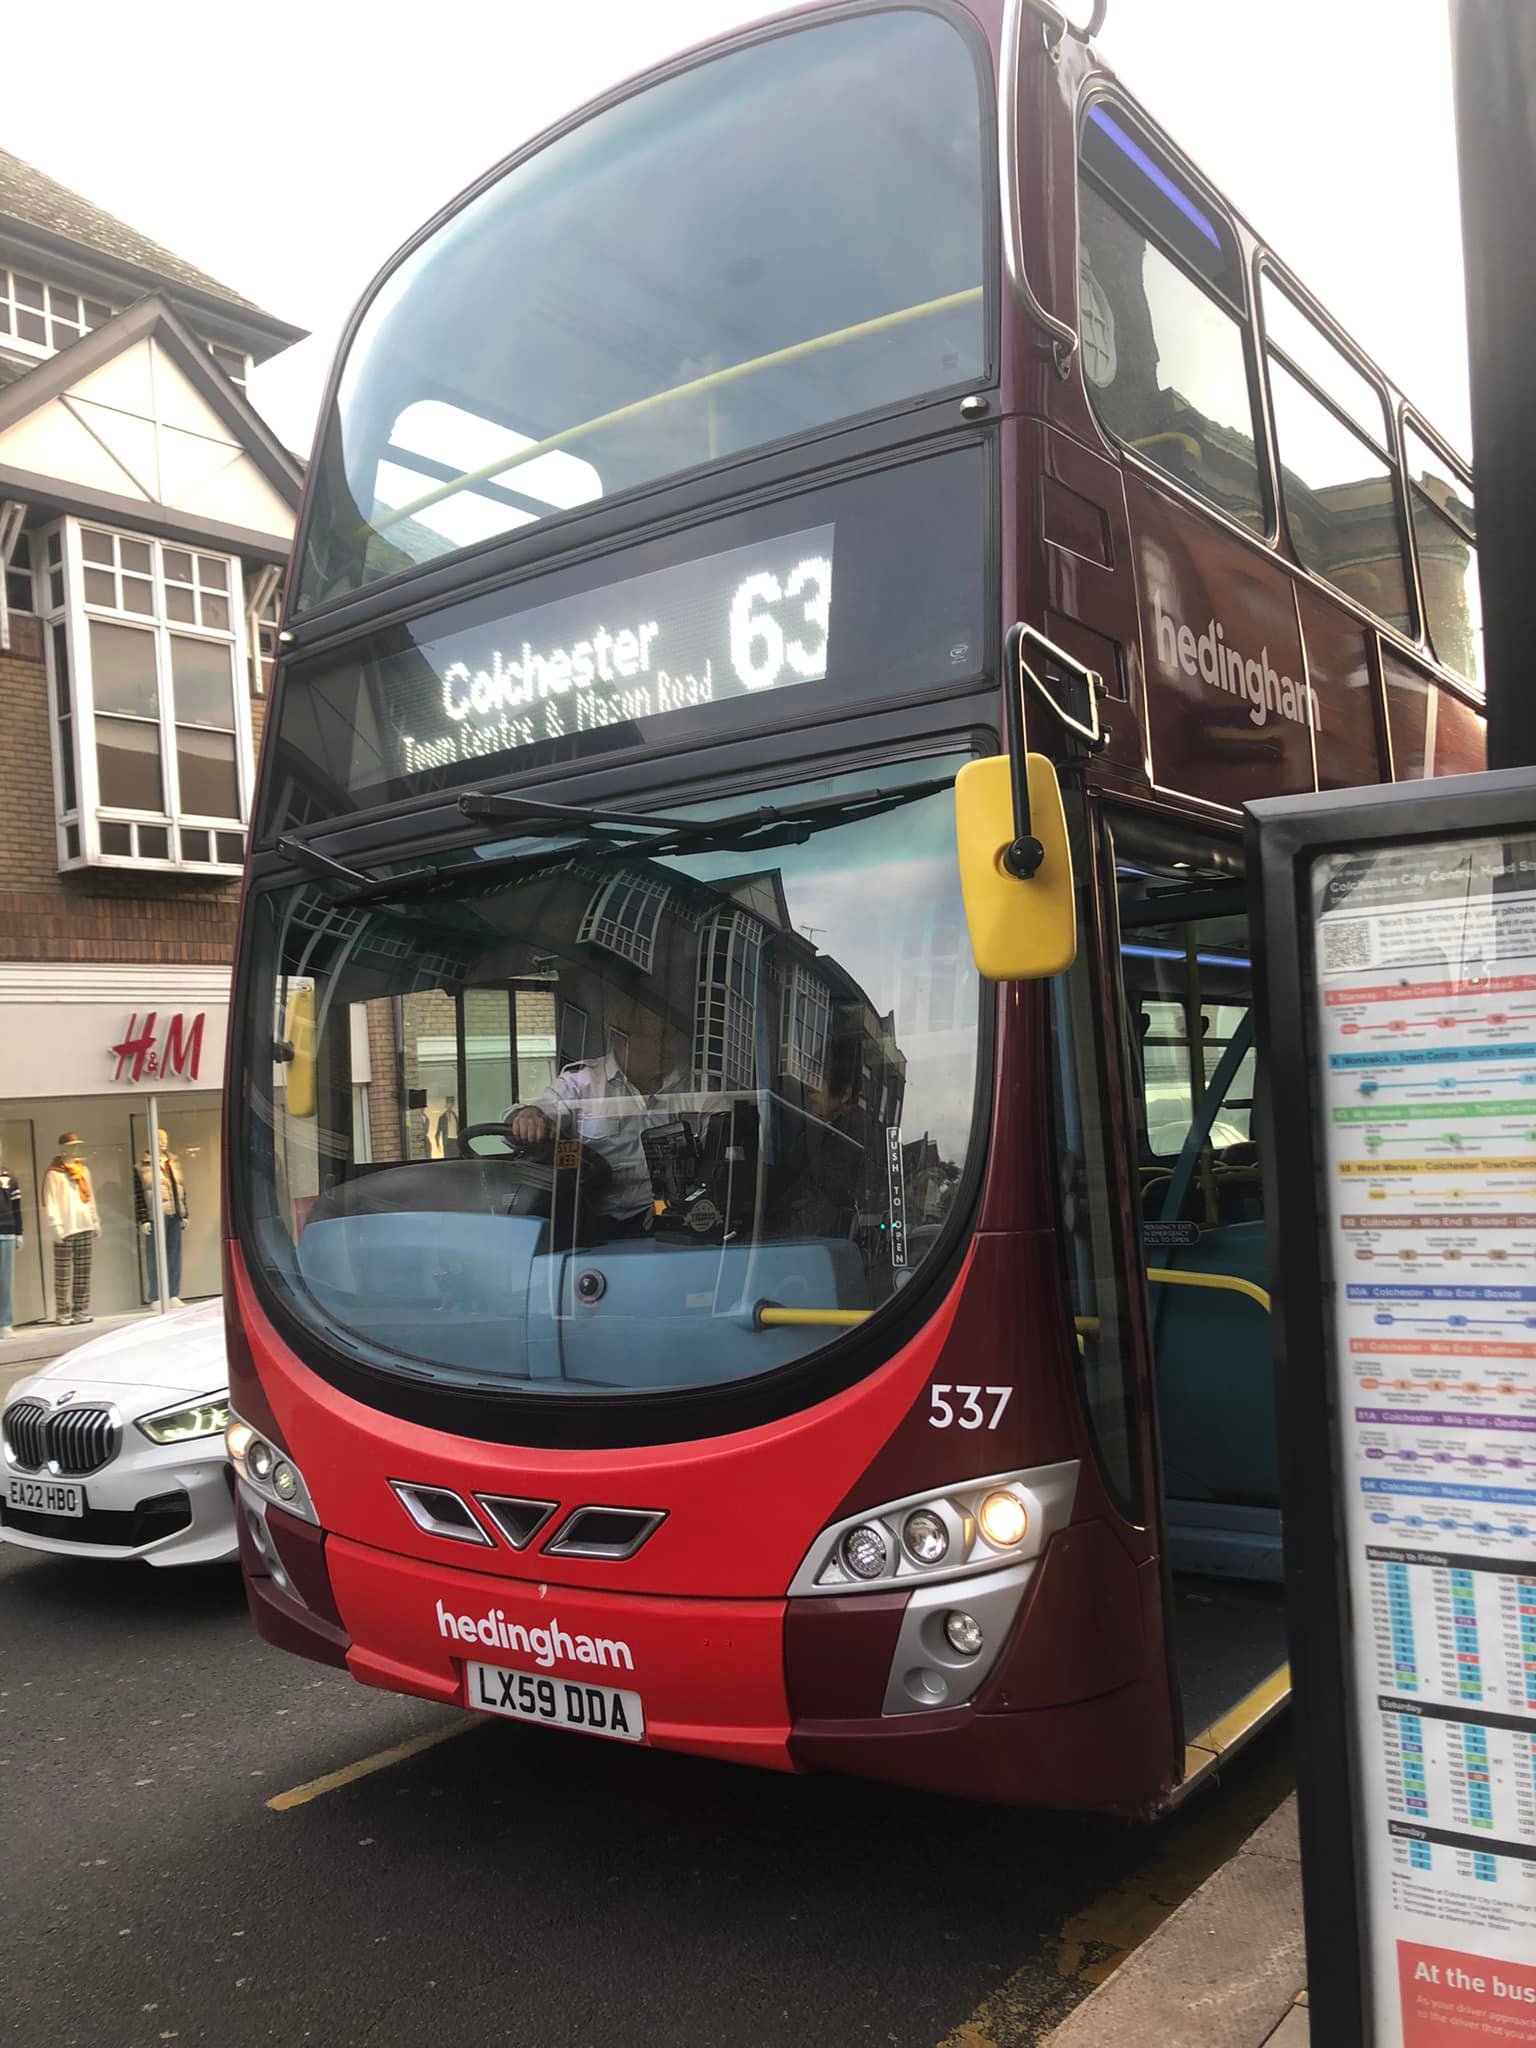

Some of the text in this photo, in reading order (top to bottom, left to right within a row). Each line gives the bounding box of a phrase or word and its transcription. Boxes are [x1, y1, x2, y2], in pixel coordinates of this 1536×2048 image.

[729, 555, 832, 691] 63
[441, 619, 660, 721] Colchester
[1154, 588, 1322, 732] hedingham
[402, 658, 713, 774] Town Centre & Mason Road
[109, 1011, 206, 1082] H&M
[889, 1129, 905, 1264] PUSH TO OPEN
[1373, 1286, 1425, 1297] Colchester
[928, 1383, 1014, 1430] 537
[10, 1482, 76, 1512] EA22 HBO
[435, 1599, 635, 1670] hedingham
[478, 1667, 629, 1733] LX59 DDA
[1414, 1961, 1536, 2004] At the bus
[1456, 2003, 1487, 2017] driver
